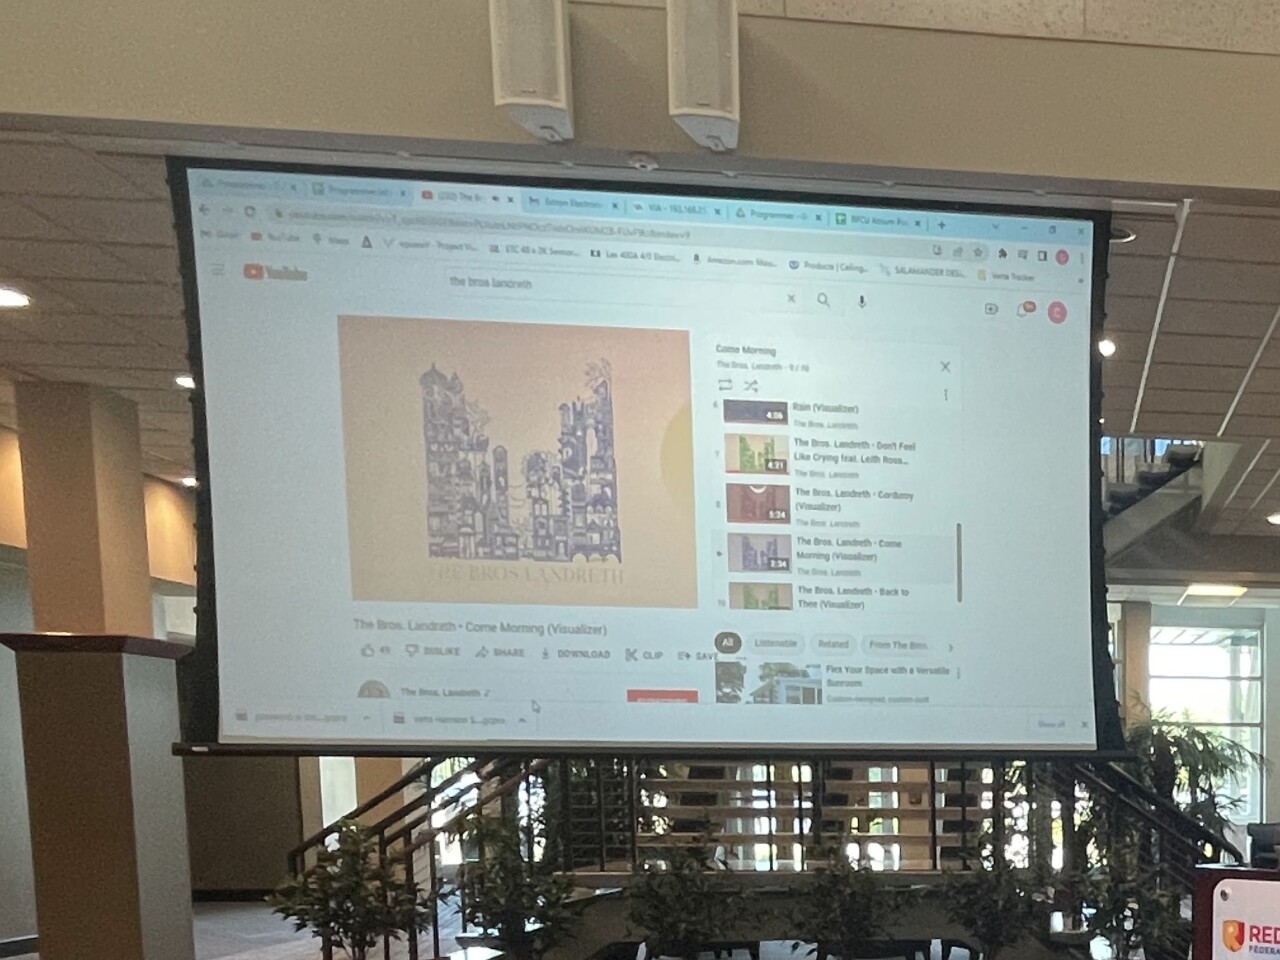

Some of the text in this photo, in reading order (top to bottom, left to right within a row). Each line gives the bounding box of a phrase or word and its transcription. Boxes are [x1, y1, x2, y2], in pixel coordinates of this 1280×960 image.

[450, 276, 466, 287] the
[716, 344, 776, 358] Come Morning
[794, 437, 809, 447] The
[899, 441, 916, 451] Feel
[794, 451, 810, 461] Like
[812, 452, 839, 465] Crying
[796, 487, 810, 497] The
[795, 502, 841, 513] (Visualizer)
[797, 536, 811, 546] The
[878, 539, 902, 549] Come
[797, 551, 877, 563] Morning (Visualizer)
[469, 565, 520, 581] BROS
[525, 567, 624, 585] LANDRETH
[798, 585, 813, 595] The
[879, 587, 899, 597] Back
[901, 588, 910, 597] to
[820, 599, 865, 610] (Visualizer)
[353, 618, 374, 630] The
[407, 620, 456, 632] Landreth
[465, 621, 498, 633] Come
[500, 622, 544, 637] Morning
[547, 622, 607, 637] (Visualizer)
[721, 637, 734, 647] All
[818, 639, 849, 649] Related
[869, 639, 891, 649] From
[892, 640, 907, 650] The
[493, 648, 525, 658] SHARE
[557, 648, 611, 660] DOWNLOAD
[643, 650, 664, 660] CLIP
[845, 665, 862, 674] Your
[865, 665, 889, 676] Space
[890, 666, 907, 675] with
